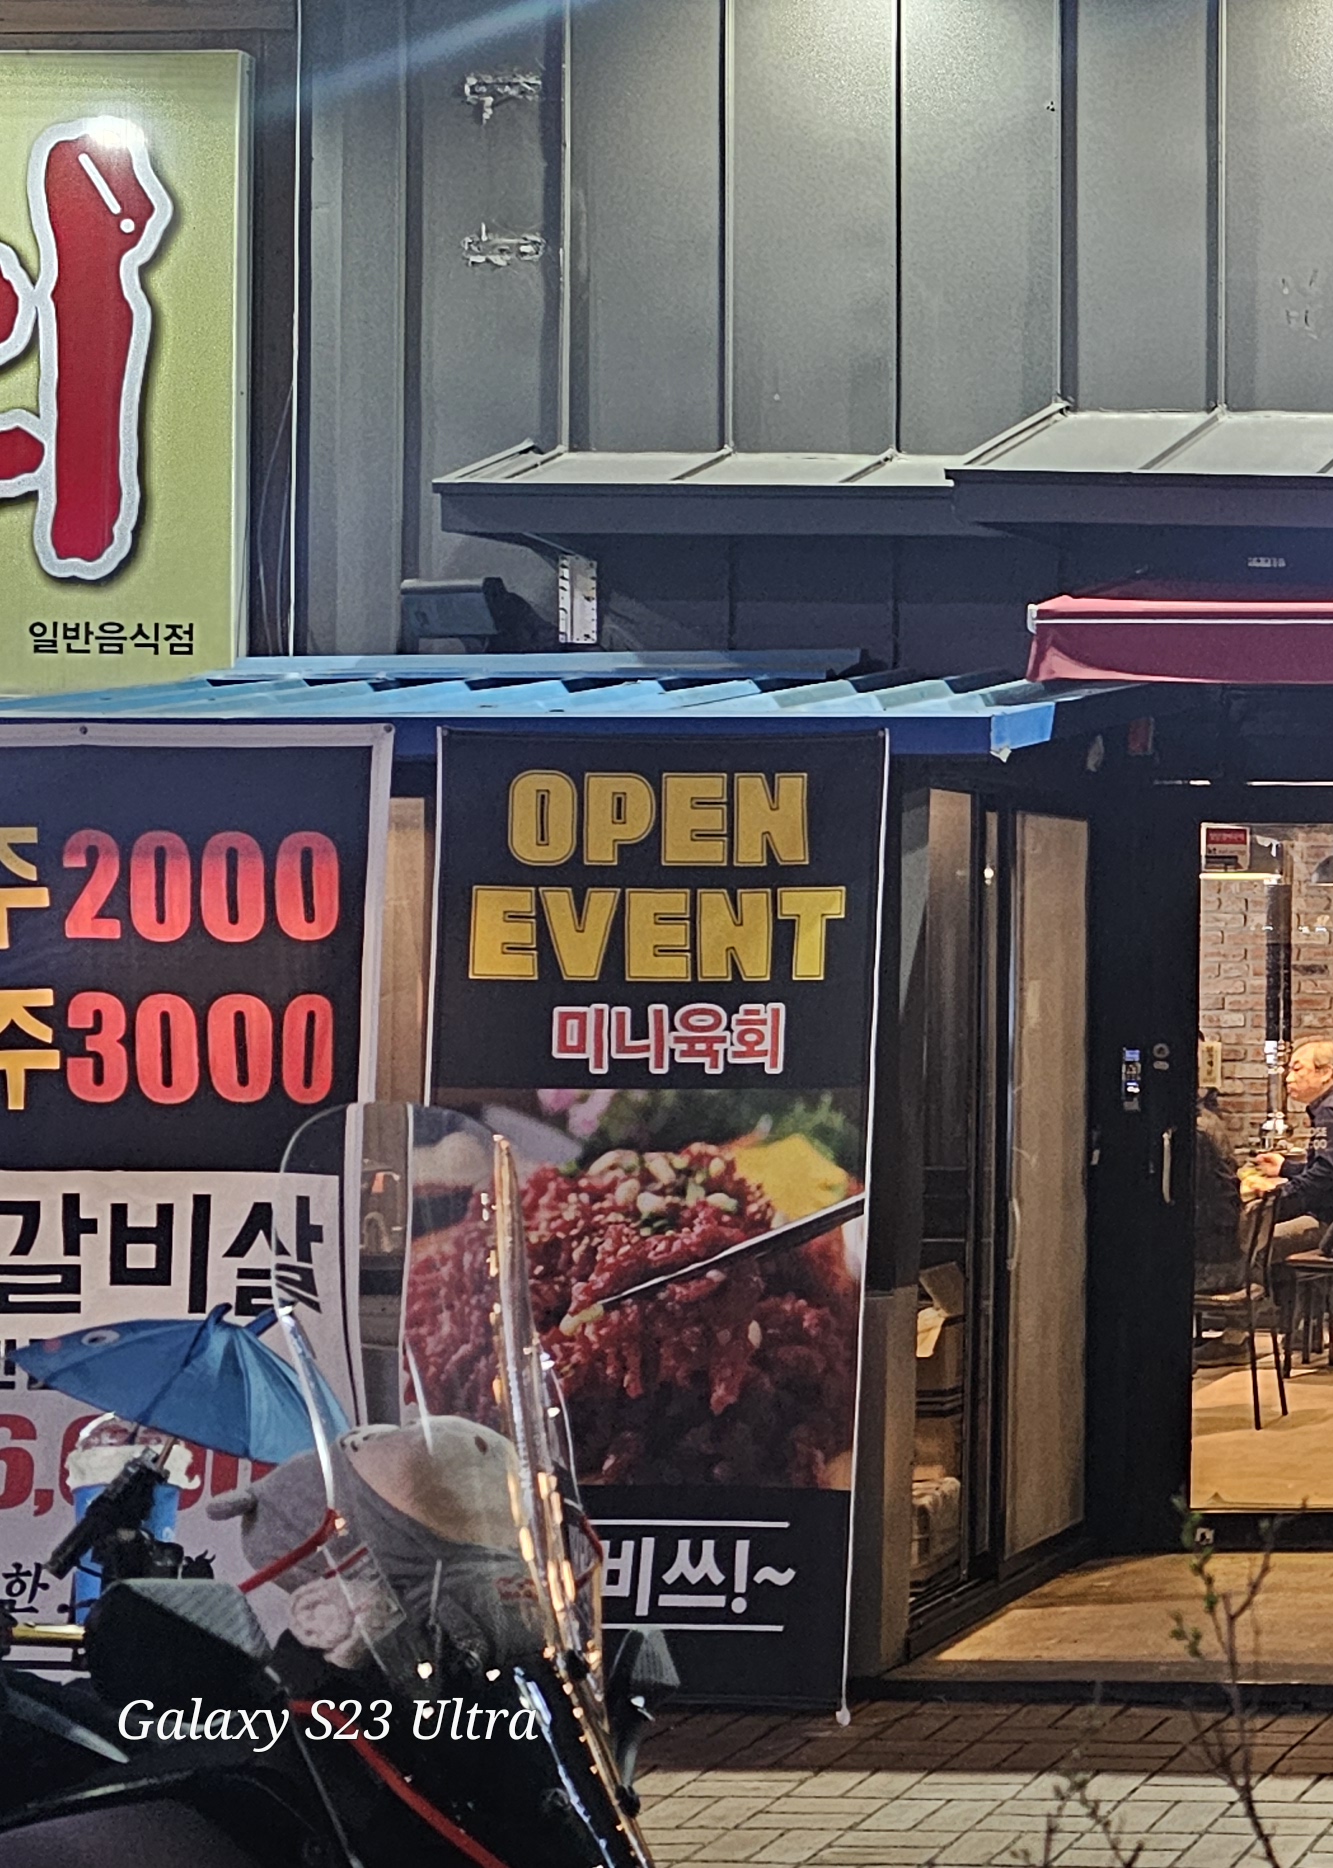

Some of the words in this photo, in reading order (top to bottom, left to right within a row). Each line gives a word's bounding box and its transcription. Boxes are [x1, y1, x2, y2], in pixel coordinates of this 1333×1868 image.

[29, 621, 195, 655] 일반음식점
[508, 769, 809, 867] OPEN
[62, 829, 340, 942] 2000
[469, 885, 846, 981] EVENT
[66, 991, 333, 1105] 3000
[550, 1003, 787, 1075] 미니육회
